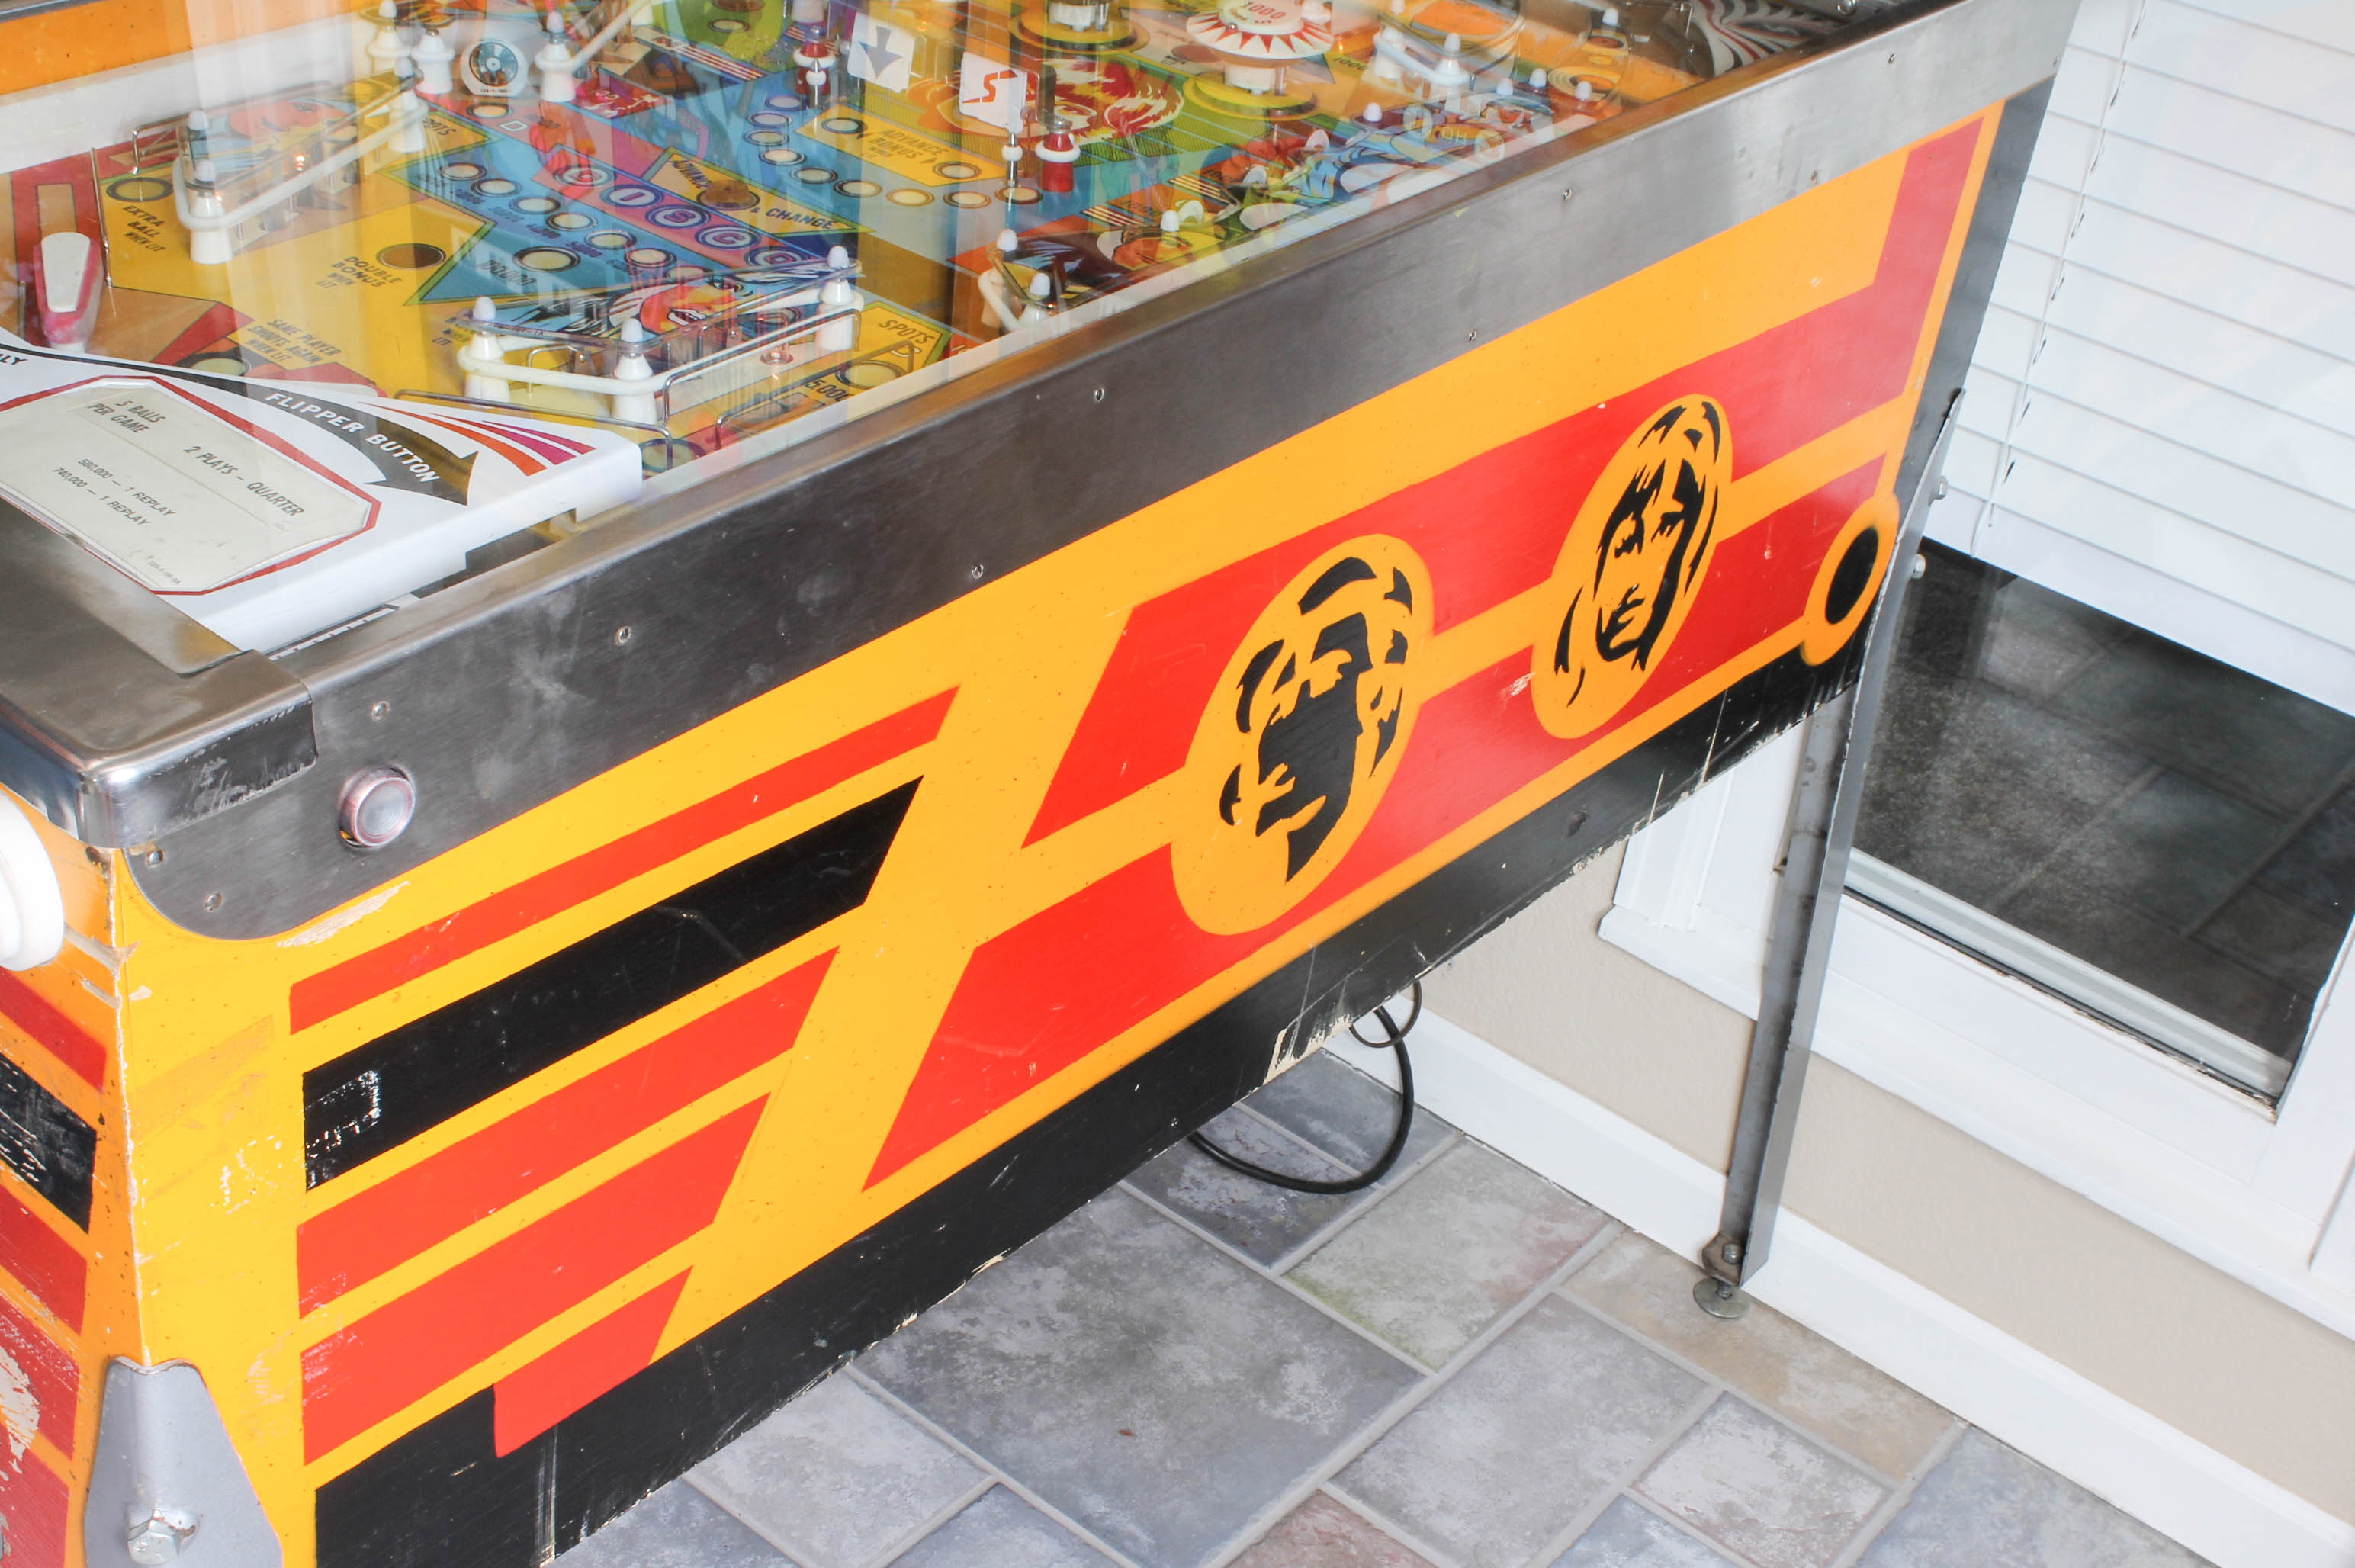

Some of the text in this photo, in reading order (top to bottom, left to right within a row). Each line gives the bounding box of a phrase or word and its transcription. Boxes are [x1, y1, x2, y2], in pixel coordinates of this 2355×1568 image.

[867, 137, 923, 159] BONUS
[122, 205, 165, 227] EXTRA
[765, 207, 836, 230] CHANGE
[124, 231, 152, 245] WHEN
[127, 221, 160, 238] BALL
[331, 262, 386, 288] BONUS
[343, 255, 403, 284] DOUBLE
[247, 325, 323, 364] SHOOTS AGAIN
[267, 318, 342, 356] SAME PLAYER
[878, 319, 936, 345] SPOTS
[86, 403, 151, 433] PER GAME
[127, 405, 167, 423] BALLS
[265, 393, 441, 483] FLIPPER BUTTON
[183, 445, 201, 454] 2
[194, 452, 239, 475] PLAYS
[246, 481, 304, 516] QUARTER
[106, 500, 151, 525] REPLAY
[131, 491, 176, 516] REPLAY
